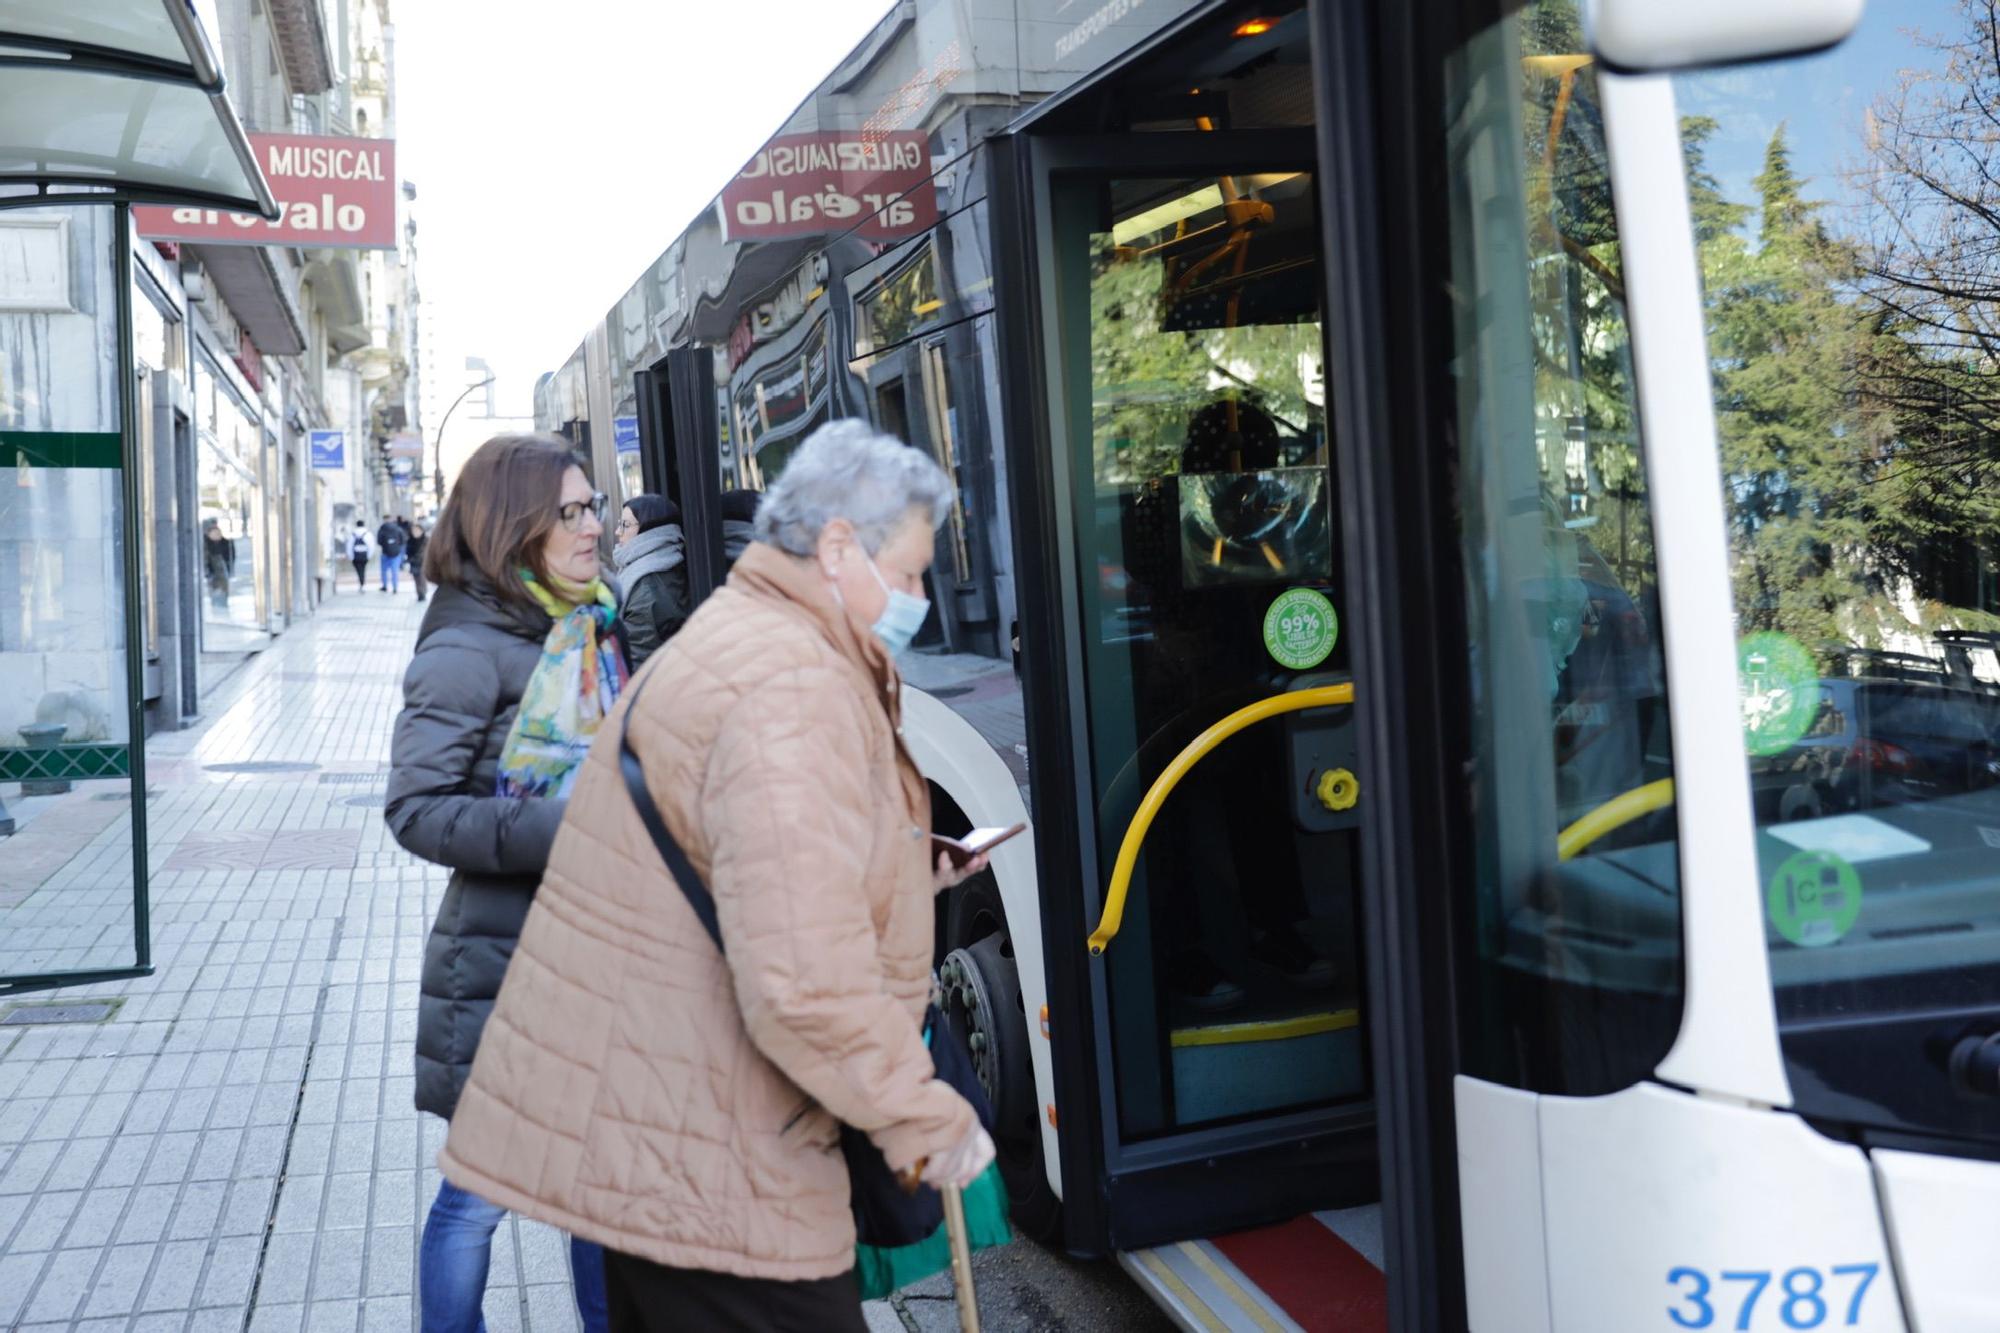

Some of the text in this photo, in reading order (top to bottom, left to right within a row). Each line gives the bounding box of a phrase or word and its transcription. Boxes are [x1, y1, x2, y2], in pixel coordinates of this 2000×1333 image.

[269, 145, 385, 181] MUSICAL
[1281, 613, 1319, 634] 99%
[1666, 1260, 1880, 1331] 3787
